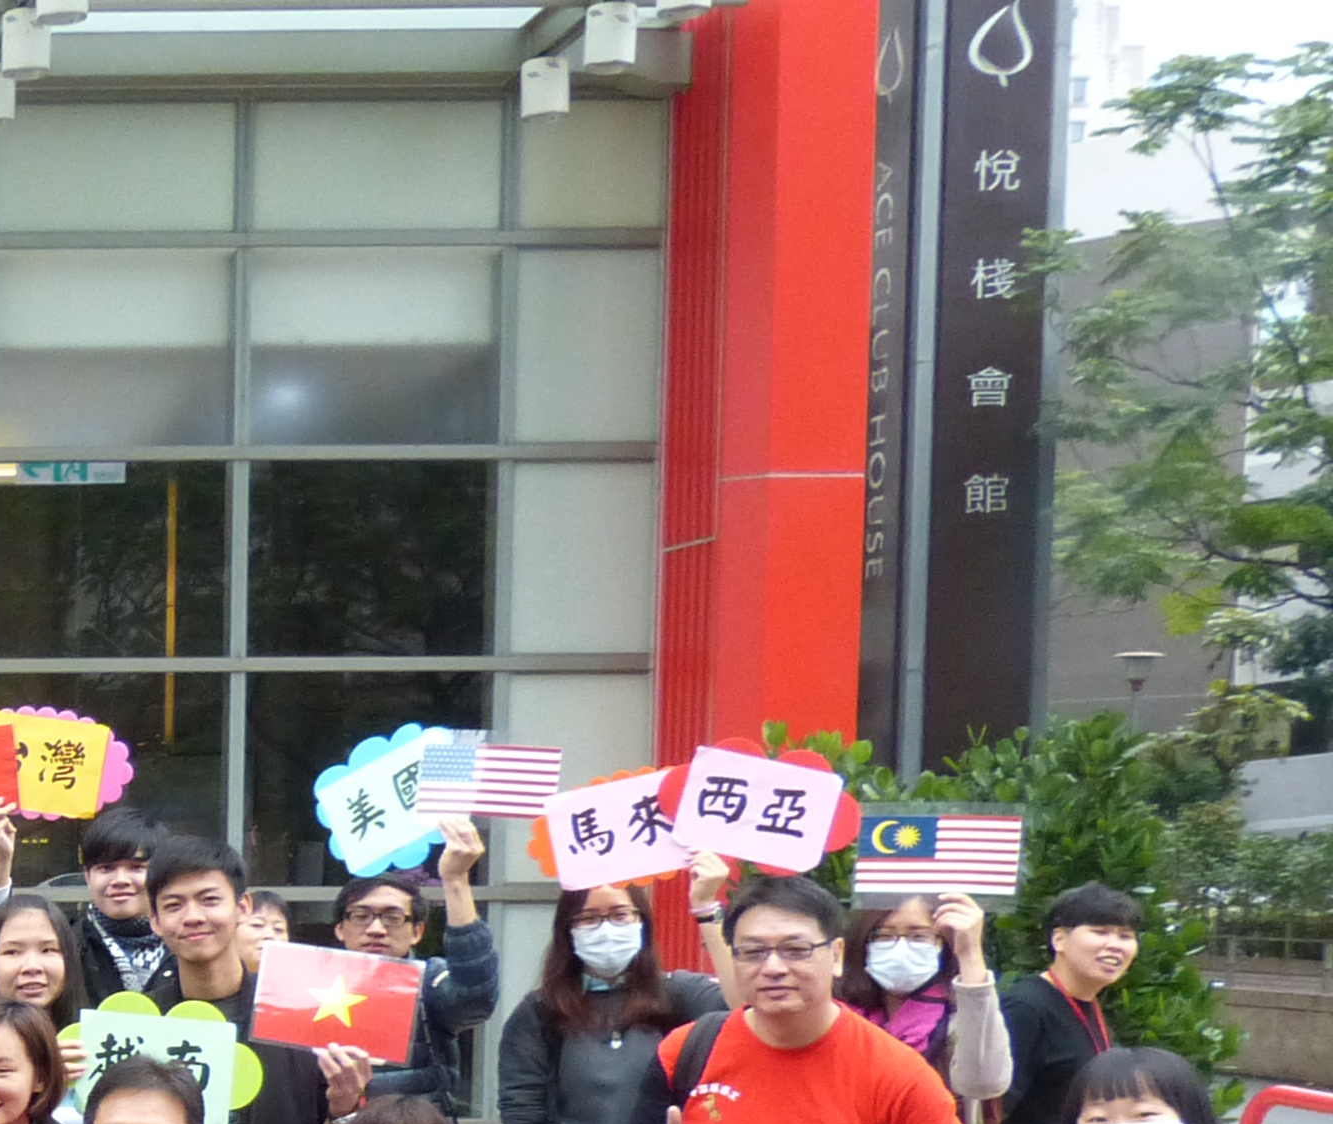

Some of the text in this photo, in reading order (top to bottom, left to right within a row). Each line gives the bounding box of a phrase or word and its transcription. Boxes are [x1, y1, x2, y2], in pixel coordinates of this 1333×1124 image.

[864, 162, 894, 579] ACE CLUB HOUSE
[962, 149, 1022, 514] 悅棧會館
